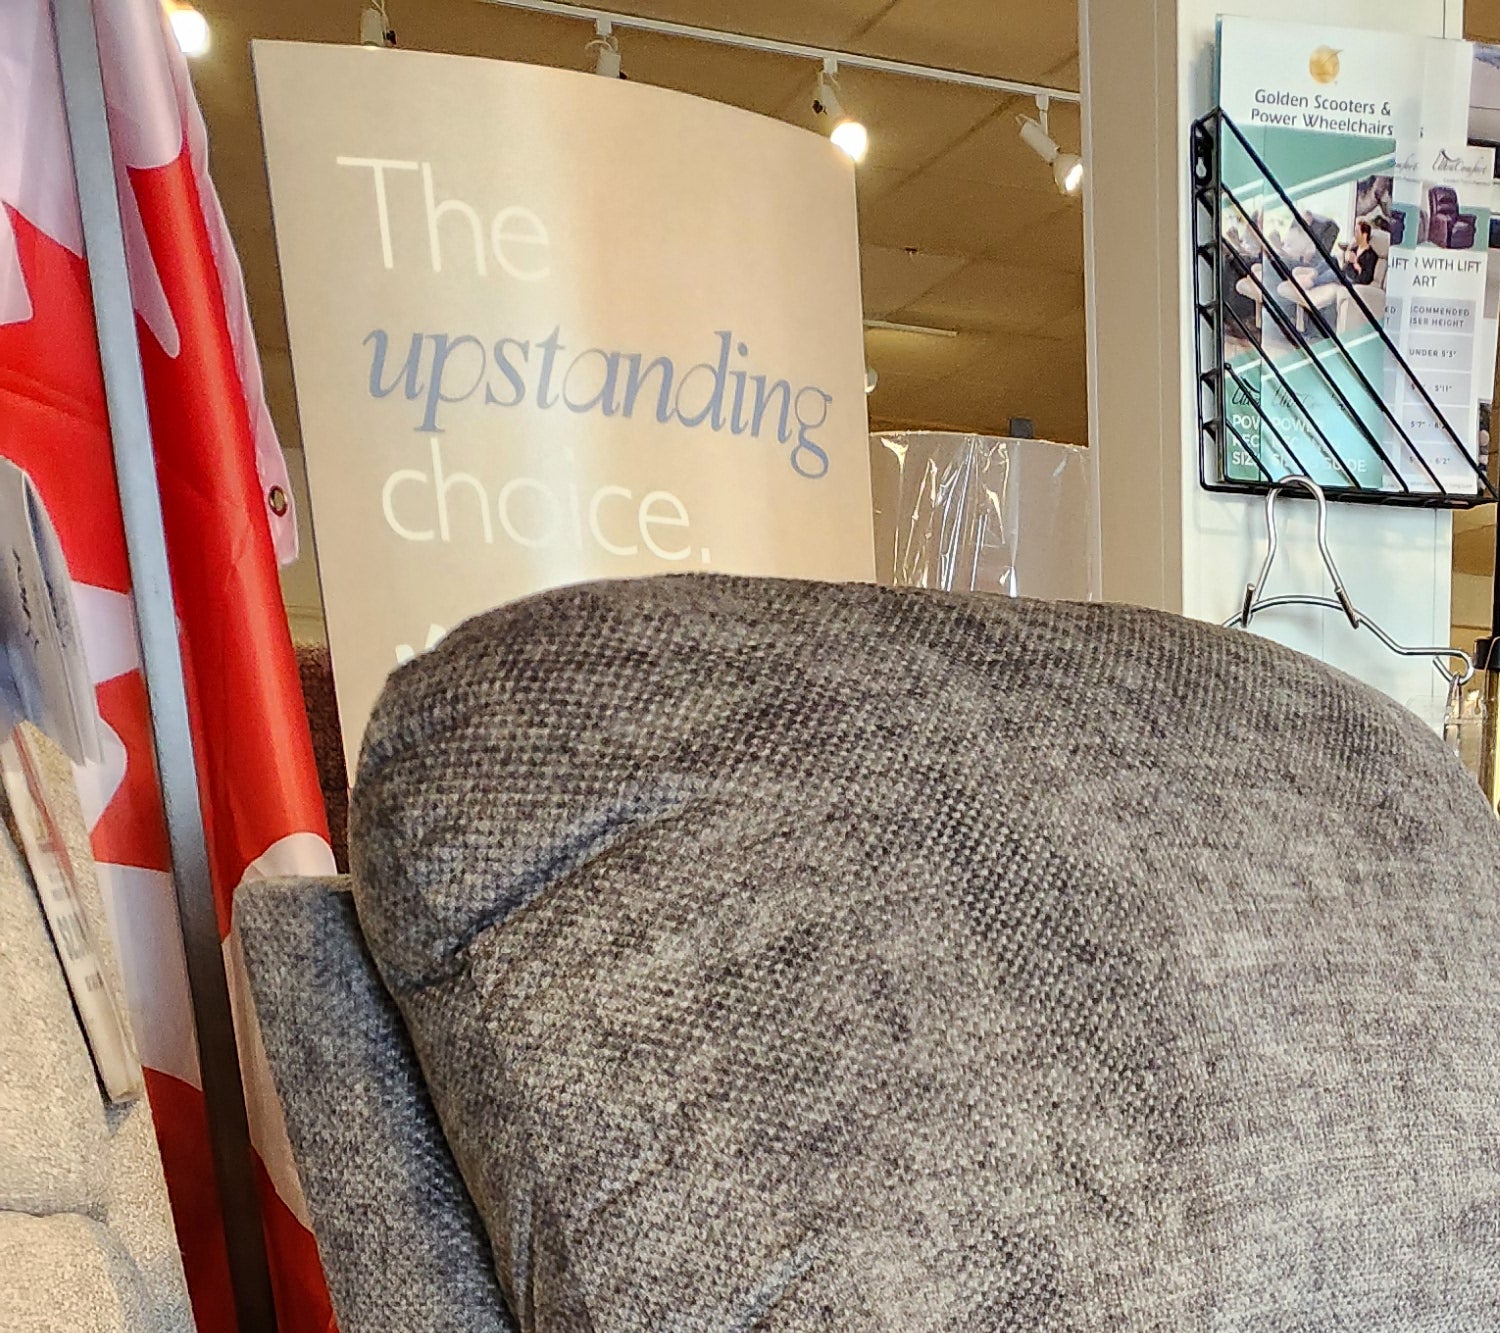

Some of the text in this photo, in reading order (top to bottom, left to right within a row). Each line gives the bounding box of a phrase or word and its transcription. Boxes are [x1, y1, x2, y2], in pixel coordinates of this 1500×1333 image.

[1254, 88, 1391, 116] Golden Scooters &
[1251, 108, 1394, 136] Power Wheelchairs
[335, 155, 552, 280] The
[1388, 256, 1409, 271] IFT
[1422, 256, 1454, 271] WITH
[1457, 258, 1482, 273] LIFT
[1412, 275, 1438, 287] ART
[1431, 318, 1464, 328] HEIGHT
[1409, 348, 1438, 358] UNDER
[361, 324, 834, 481] upstanding
[380, 439, 712, 564] choice.
